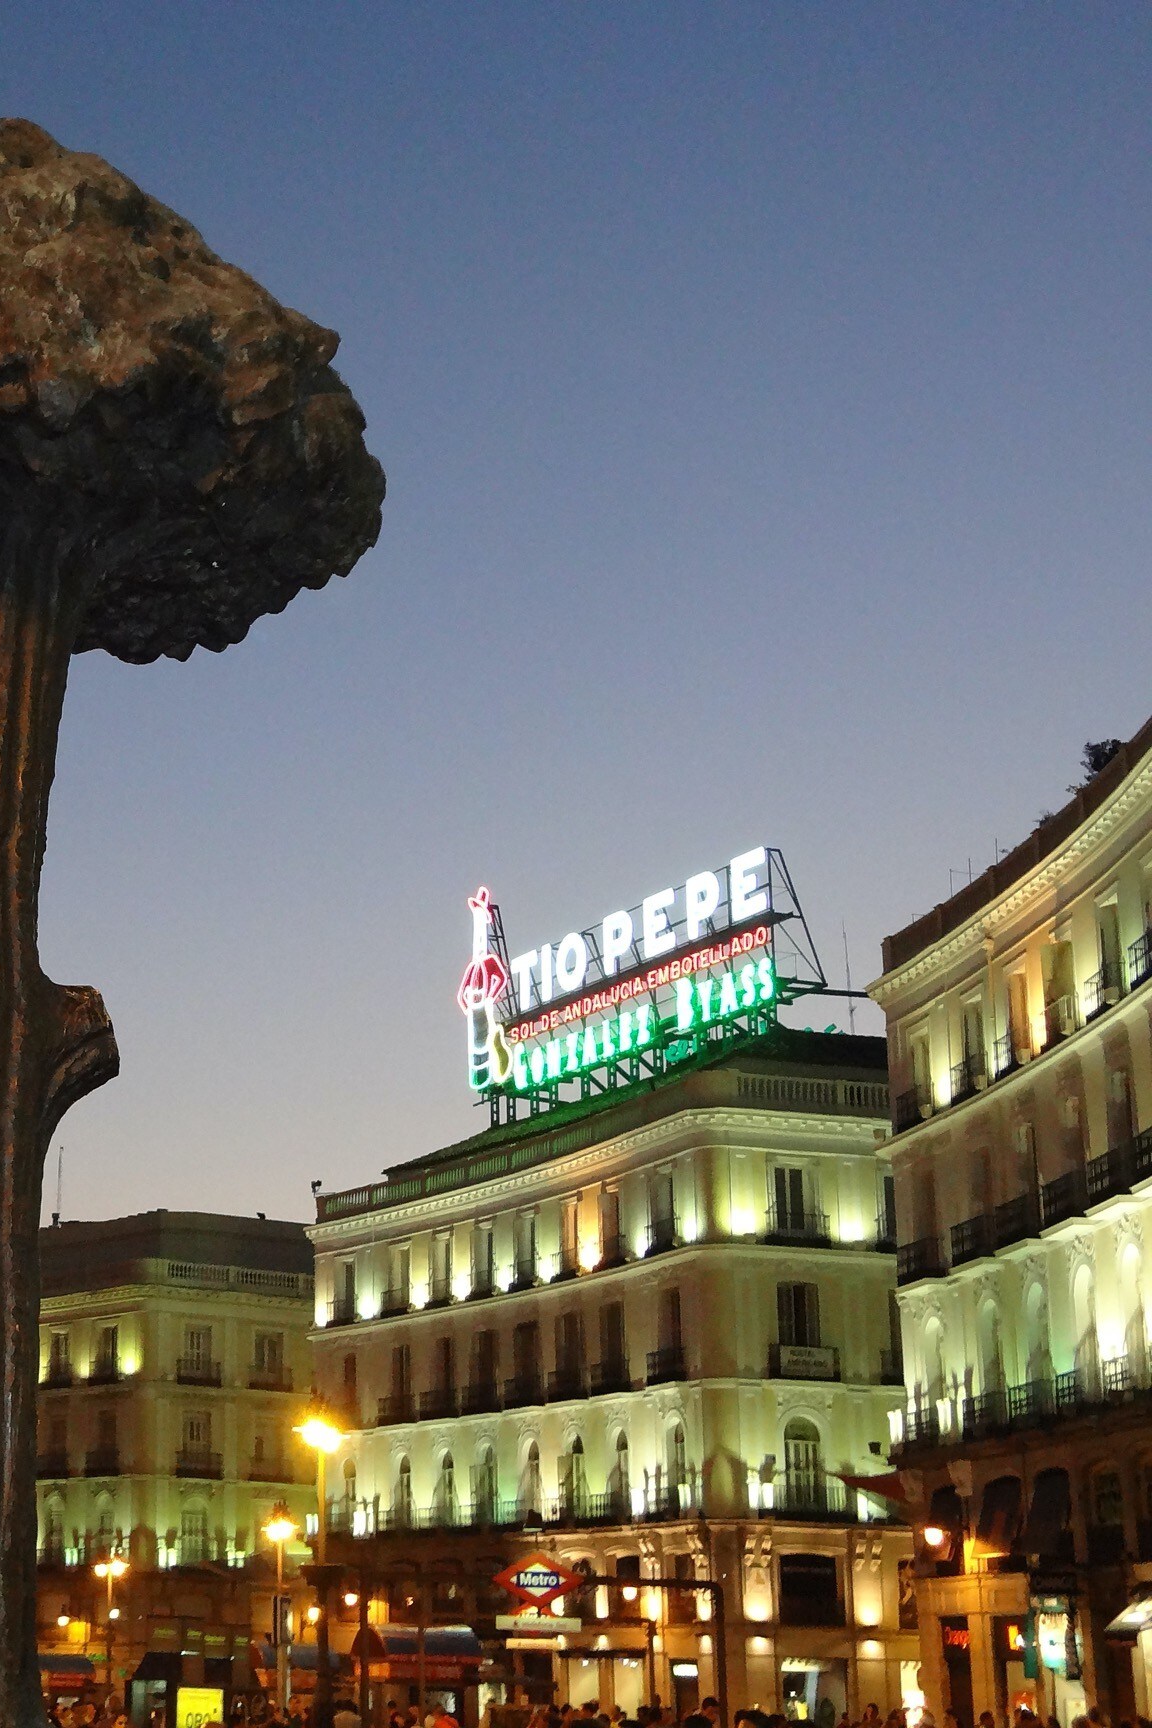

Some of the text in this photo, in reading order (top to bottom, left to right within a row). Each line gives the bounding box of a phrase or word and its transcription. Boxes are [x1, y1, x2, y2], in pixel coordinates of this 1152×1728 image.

[510, 846, 770, 1012] TIO PEPE
[510, 926, 769, 1044] SOL DE ANDALUCIA EMBOTELLADO
[514, 957, 773, 1090] GONZALEZ BYASS
[519, 1572, 558, 1586] Metro
